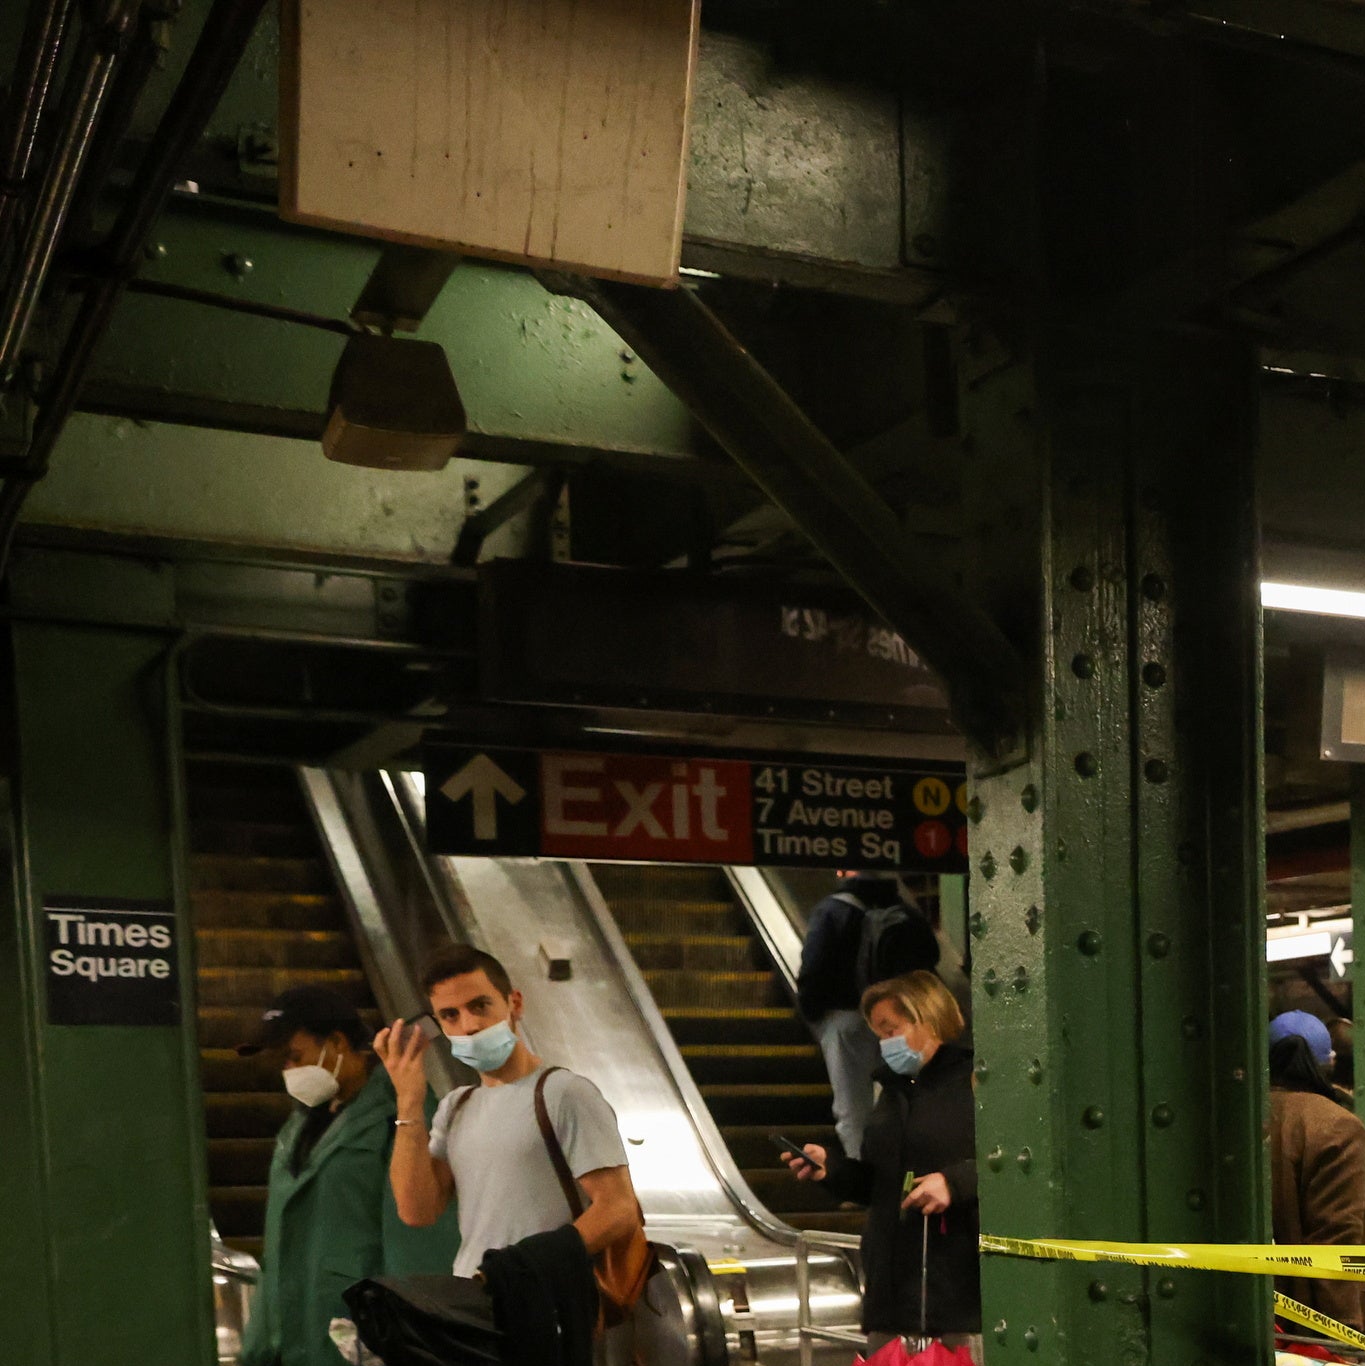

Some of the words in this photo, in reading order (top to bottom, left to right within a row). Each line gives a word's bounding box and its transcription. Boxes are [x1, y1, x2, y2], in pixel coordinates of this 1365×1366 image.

[544, 754, 728, 842] Exit
[755, 767, 789, 794] 41
[802, 769, 894, 799] Street
[921, 786, 941, 807] N
[755, 798, 774, 823] 7
[788, 800, 894, 829] Avenue
[757, 828, 848, 857] Times
[861, 832, 900, 864] Sq
[48, 913, 172, 949] Times
[50, 949, 170, 982] Square
